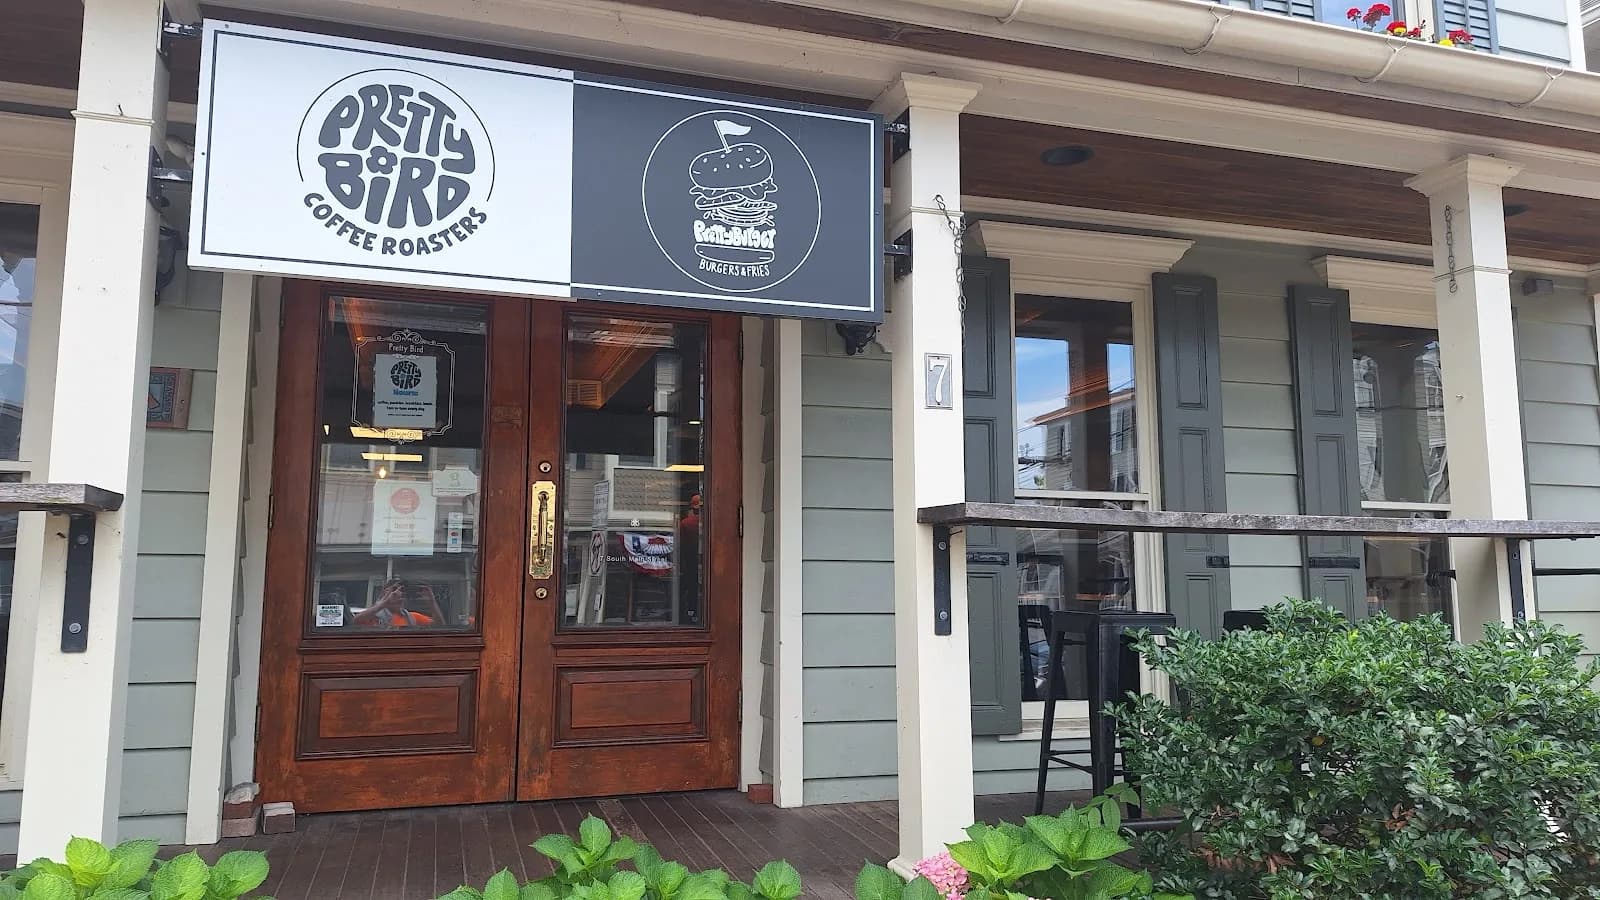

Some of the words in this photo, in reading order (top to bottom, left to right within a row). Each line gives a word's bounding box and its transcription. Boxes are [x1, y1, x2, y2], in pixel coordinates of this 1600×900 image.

[318, 83, 476, 174] PRETTY
[303, 192, 378, 252] COFFEE
[381, 206, 487, 257] ROASTERS
[388, 342, 408, 353] Pretty
[410, 344, 424, 353] Bird
[929, 359, 948, 403] 7
